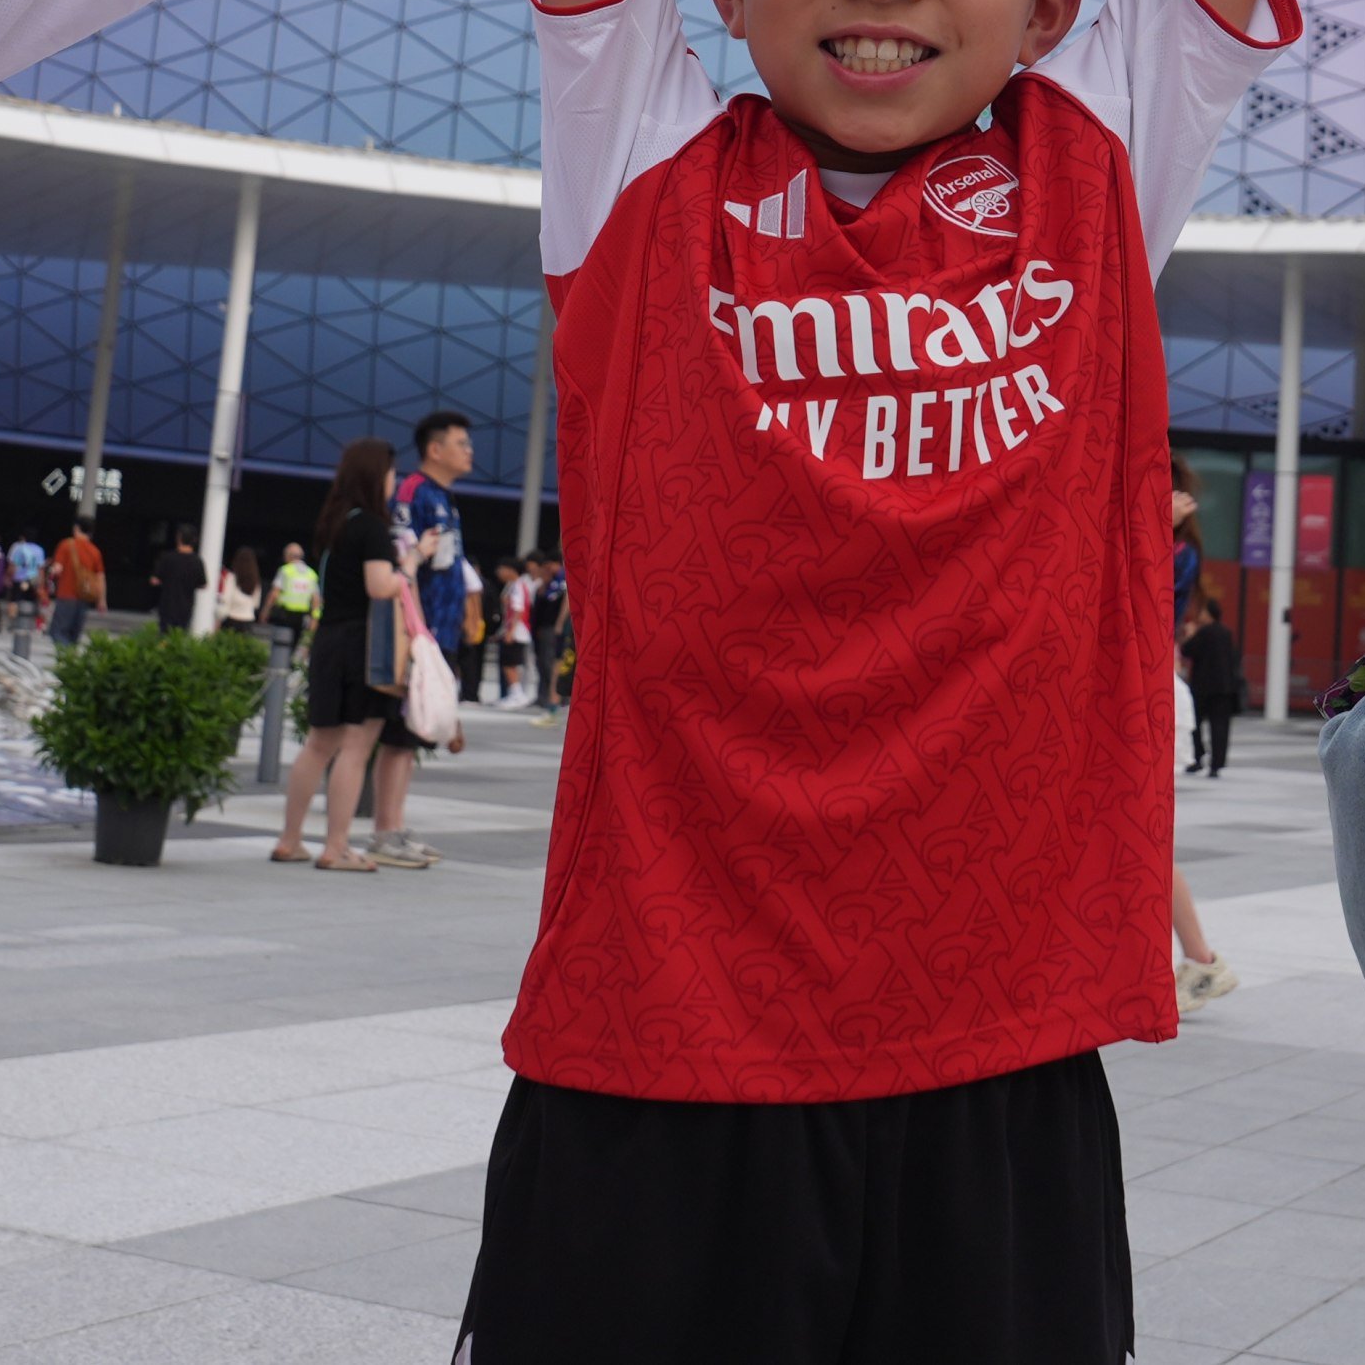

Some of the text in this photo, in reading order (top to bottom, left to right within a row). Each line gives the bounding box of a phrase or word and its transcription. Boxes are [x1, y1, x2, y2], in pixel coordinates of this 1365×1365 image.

[935, 163, 998, 199] Arsenal
[862, 364, 1065, 480] BETTER
[69, 485, 121, 505] TIETS
